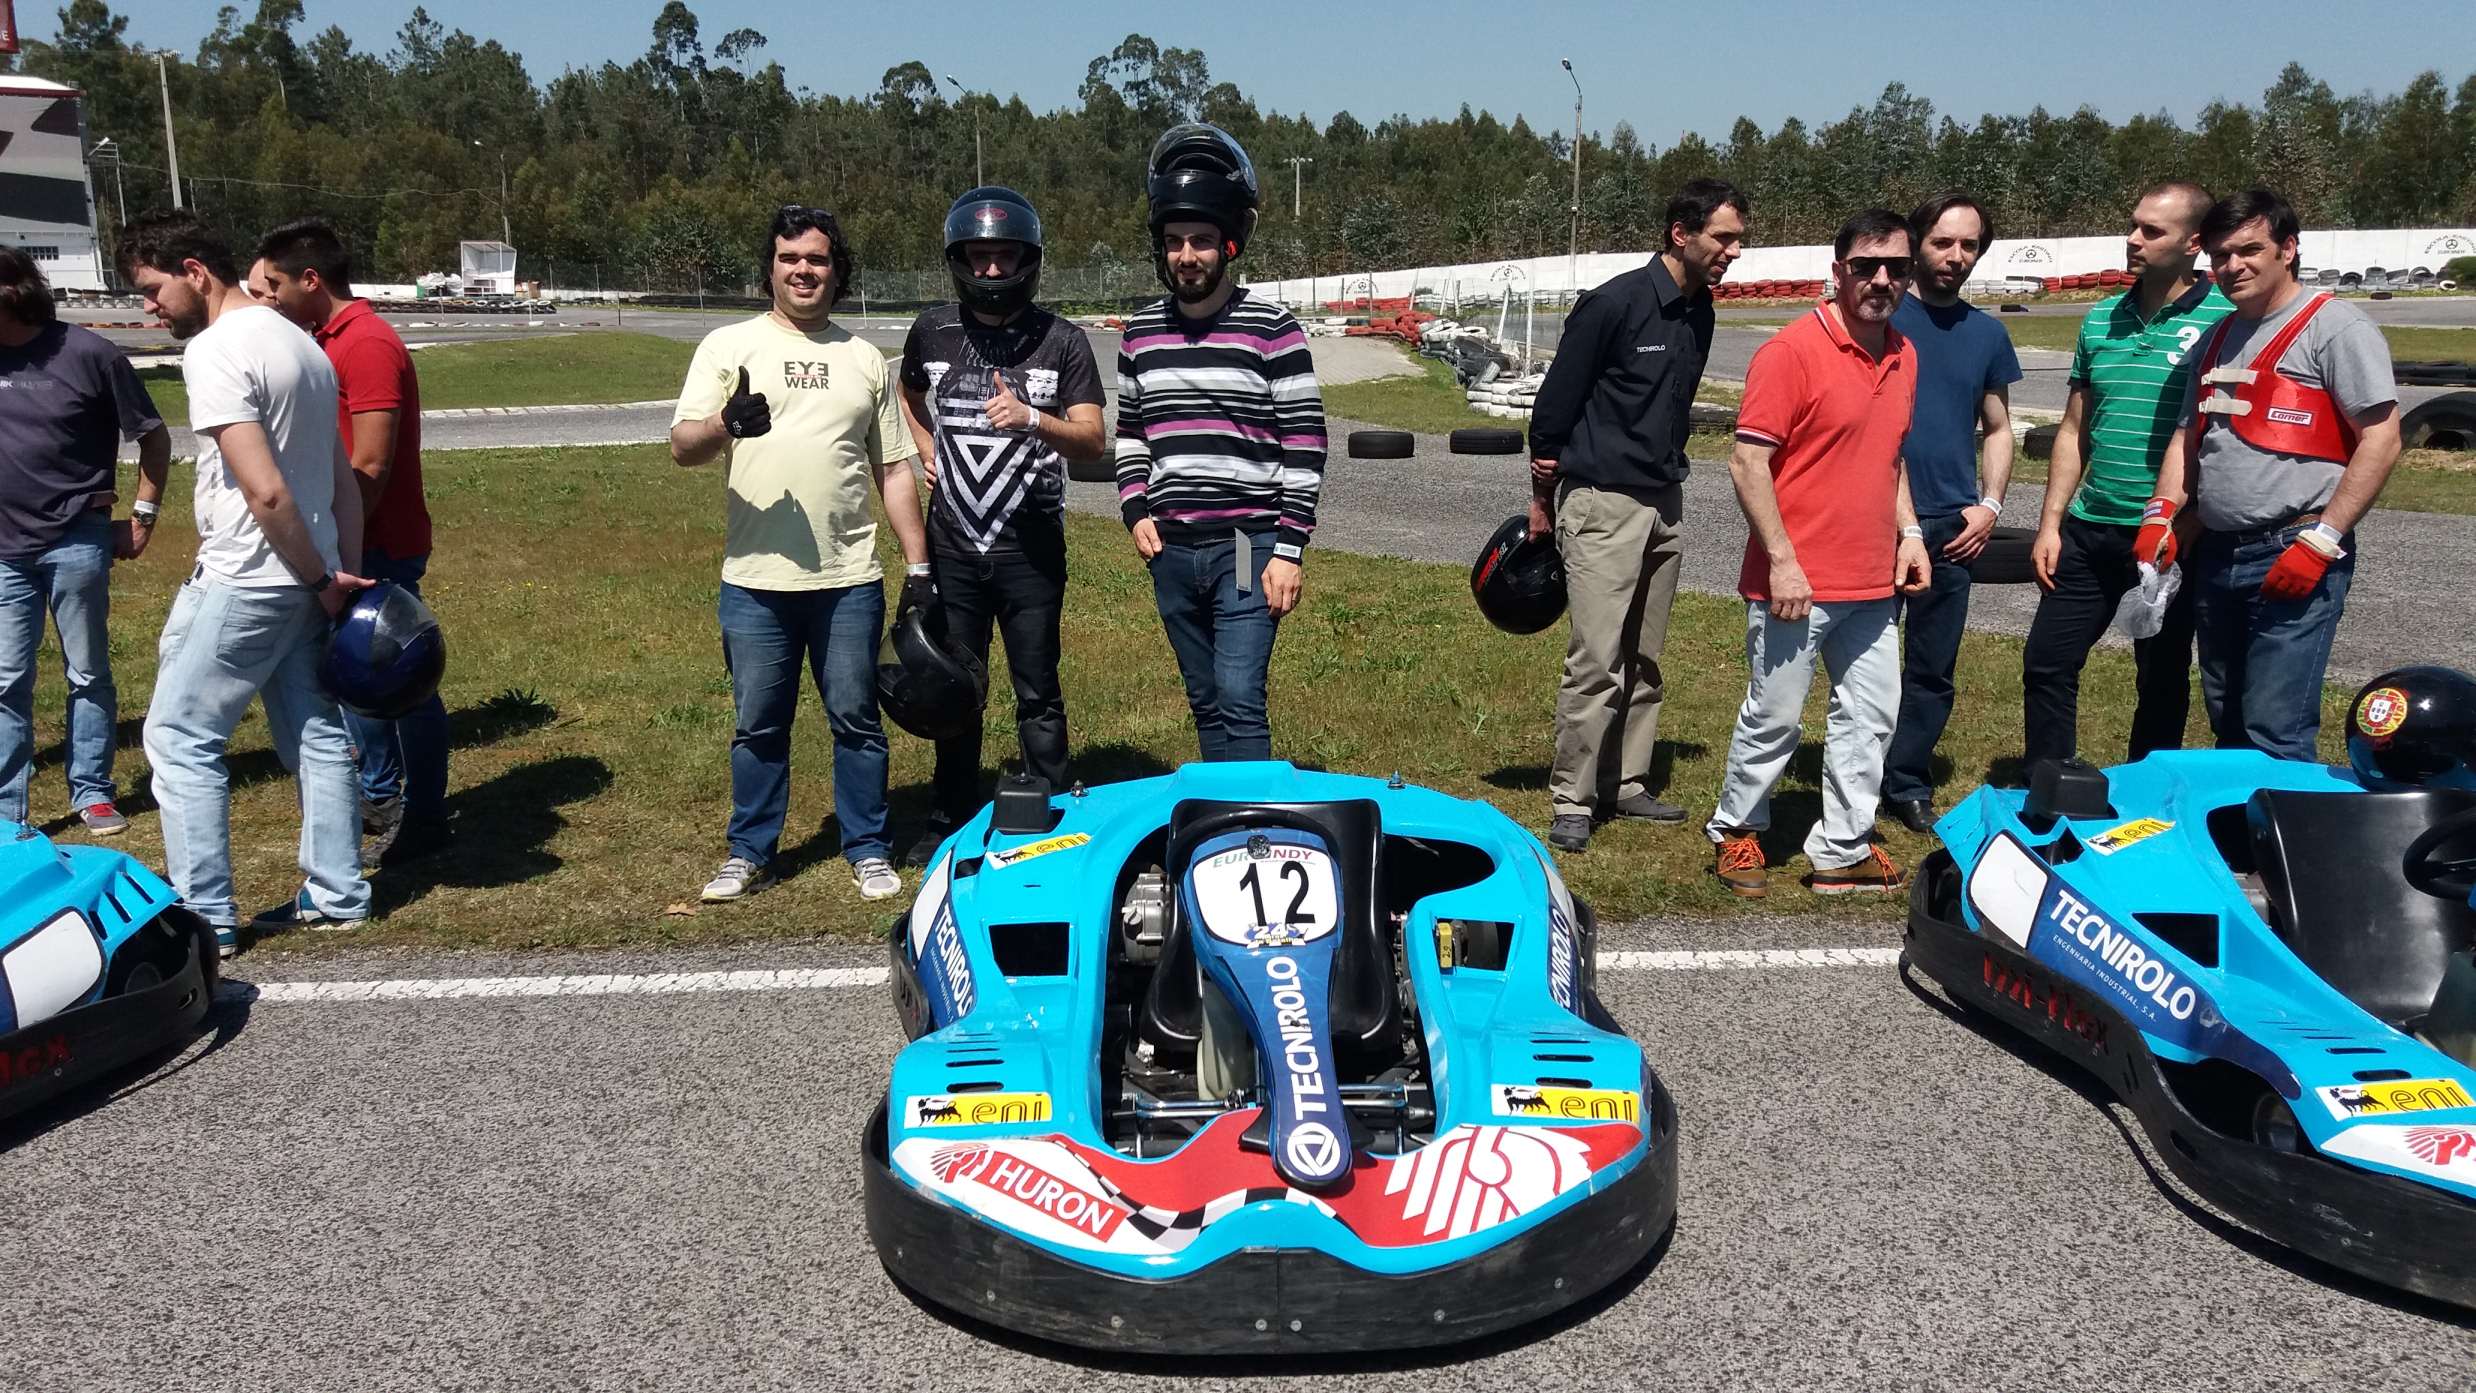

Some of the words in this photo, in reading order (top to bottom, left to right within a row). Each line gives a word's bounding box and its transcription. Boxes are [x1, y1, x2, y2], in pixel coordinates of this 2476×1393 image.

[2166, 326, 2200, 366] 3
[784, 377, 830, 390] WEAR
[1036, 833, 1088, 853] eni
[2124, 818, 2172, 839] eni
[1213, 848, 1312, 868] EURNDY
[1239, 860, 1316, 927] 12
[2050, 889, 2196, 1020] TECNIROLO
[2053, 935, 2096, 972] ENGENHARIA
[1266, 956, 1327, 1121] TECNIROLO
[972, 1093, 1042, 1125] eni
[1560, 1091, 1633, 1123] eni
[2390, 1079, 2469, 1112] eni
[990, 1158, 1114, 1235] HURON
